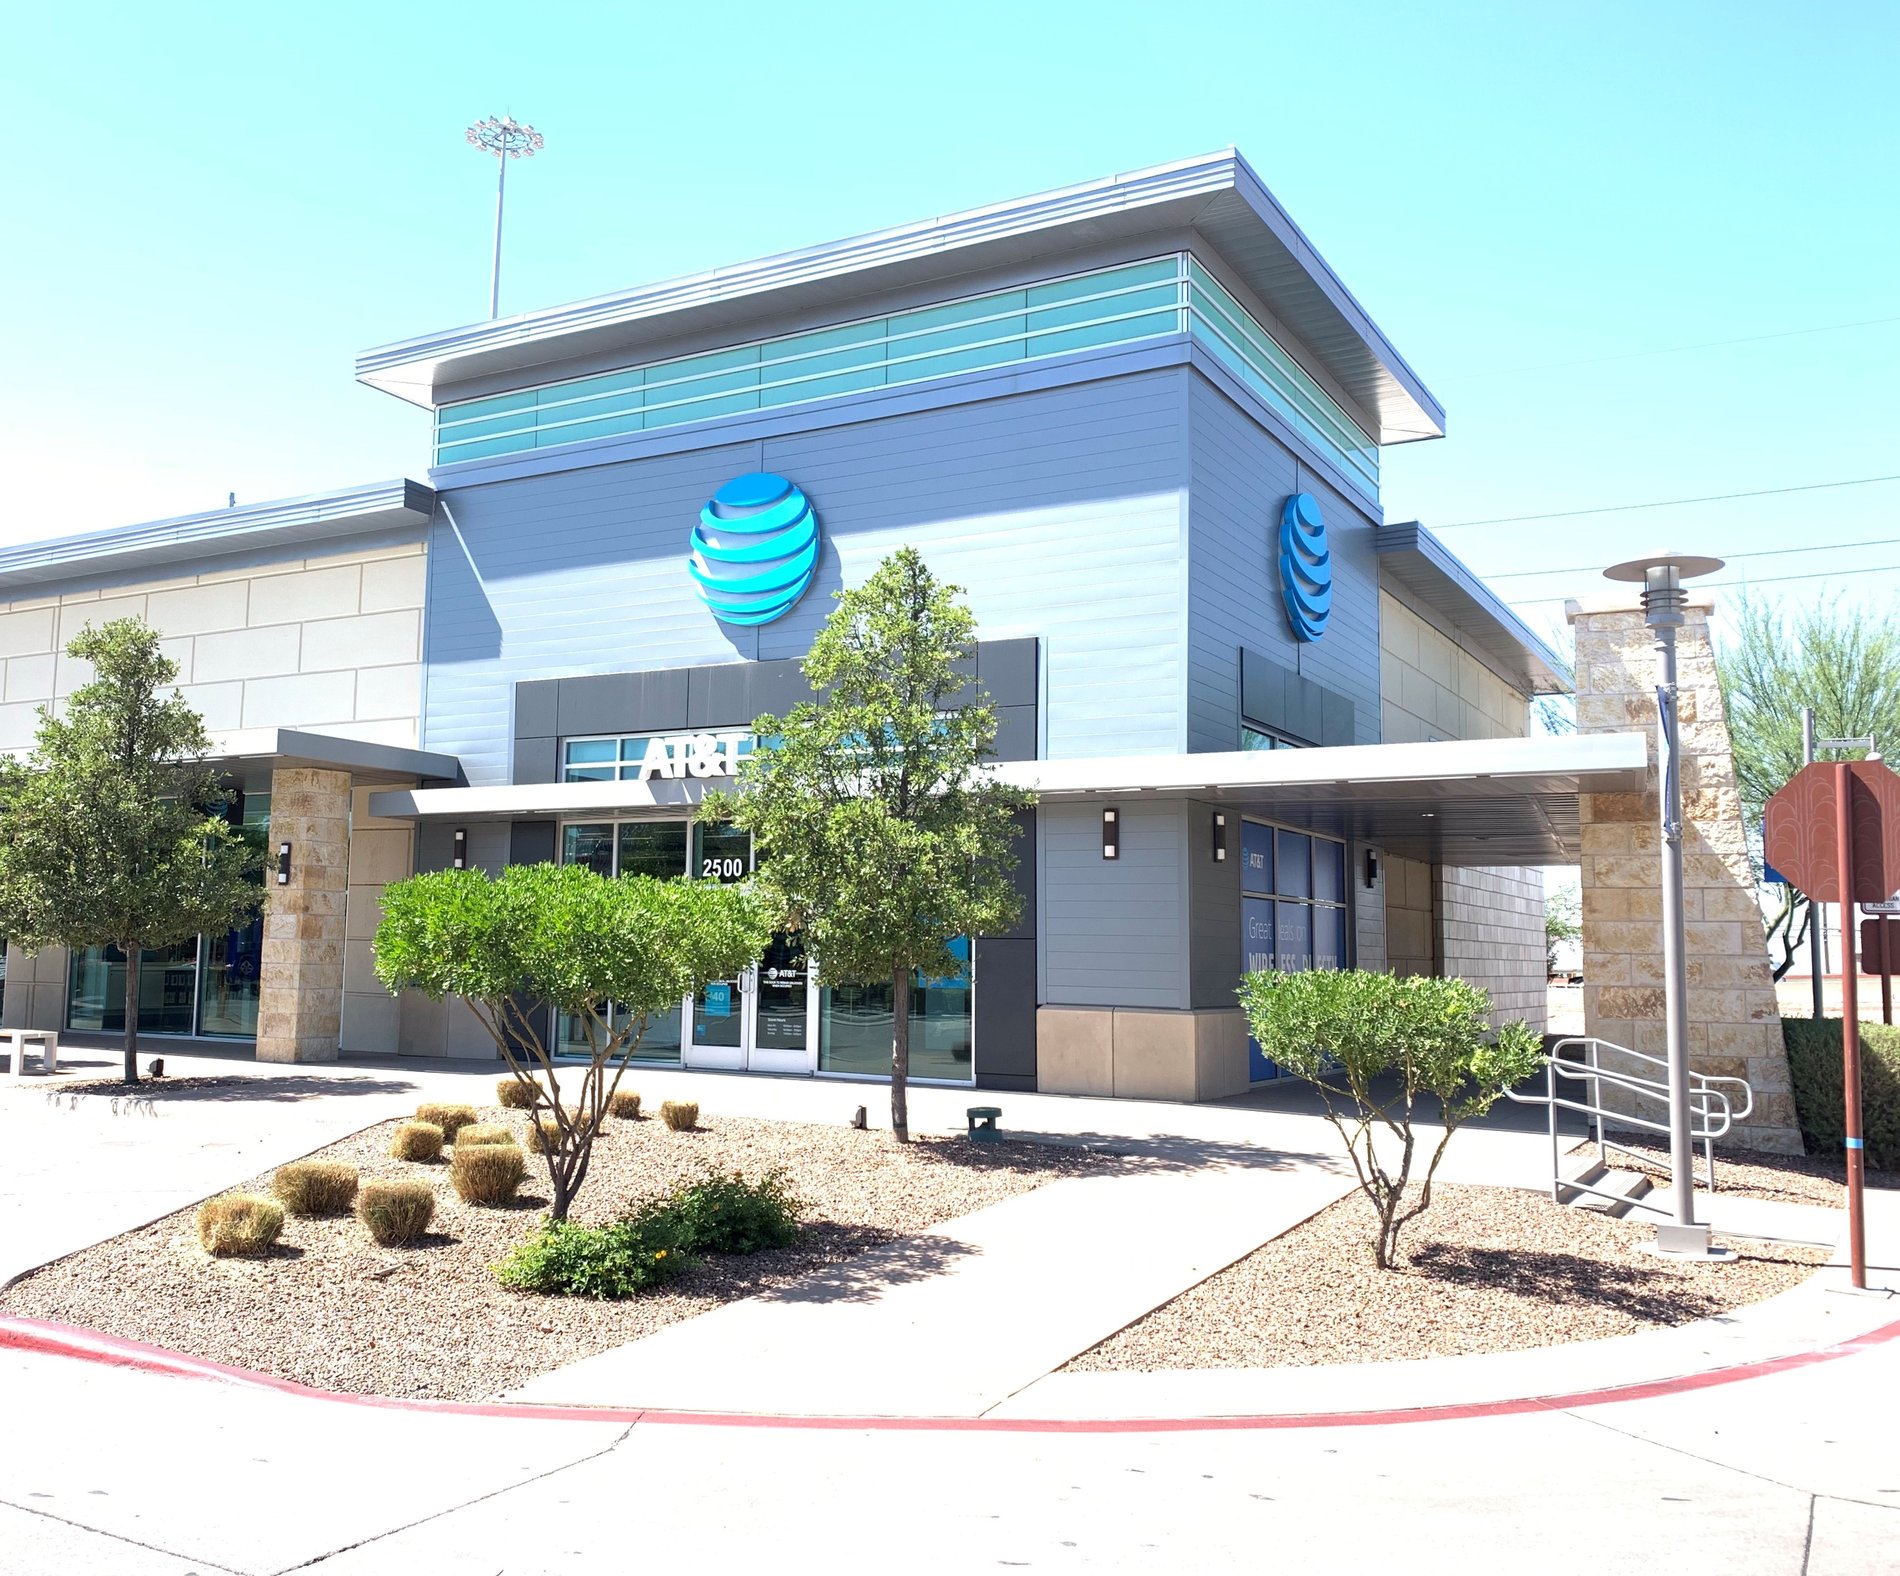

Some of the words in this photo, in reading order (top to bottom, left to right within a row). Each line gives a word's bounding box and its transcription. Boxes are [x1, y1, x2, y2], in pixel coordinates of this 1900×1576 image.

[638, 733, 749, 781] AT&T
[702, 858, 743, 877] 2500
[1250, 852, 1264, 869] AT&T
[1249, 916, 1273, 940] Great
[1280, 919, 1295, 941] eals
[1296, 926, 1307, 942] on
[1248, 952, 1297, 973] WIREESS
[779, 969, 797, 978] AT&T
